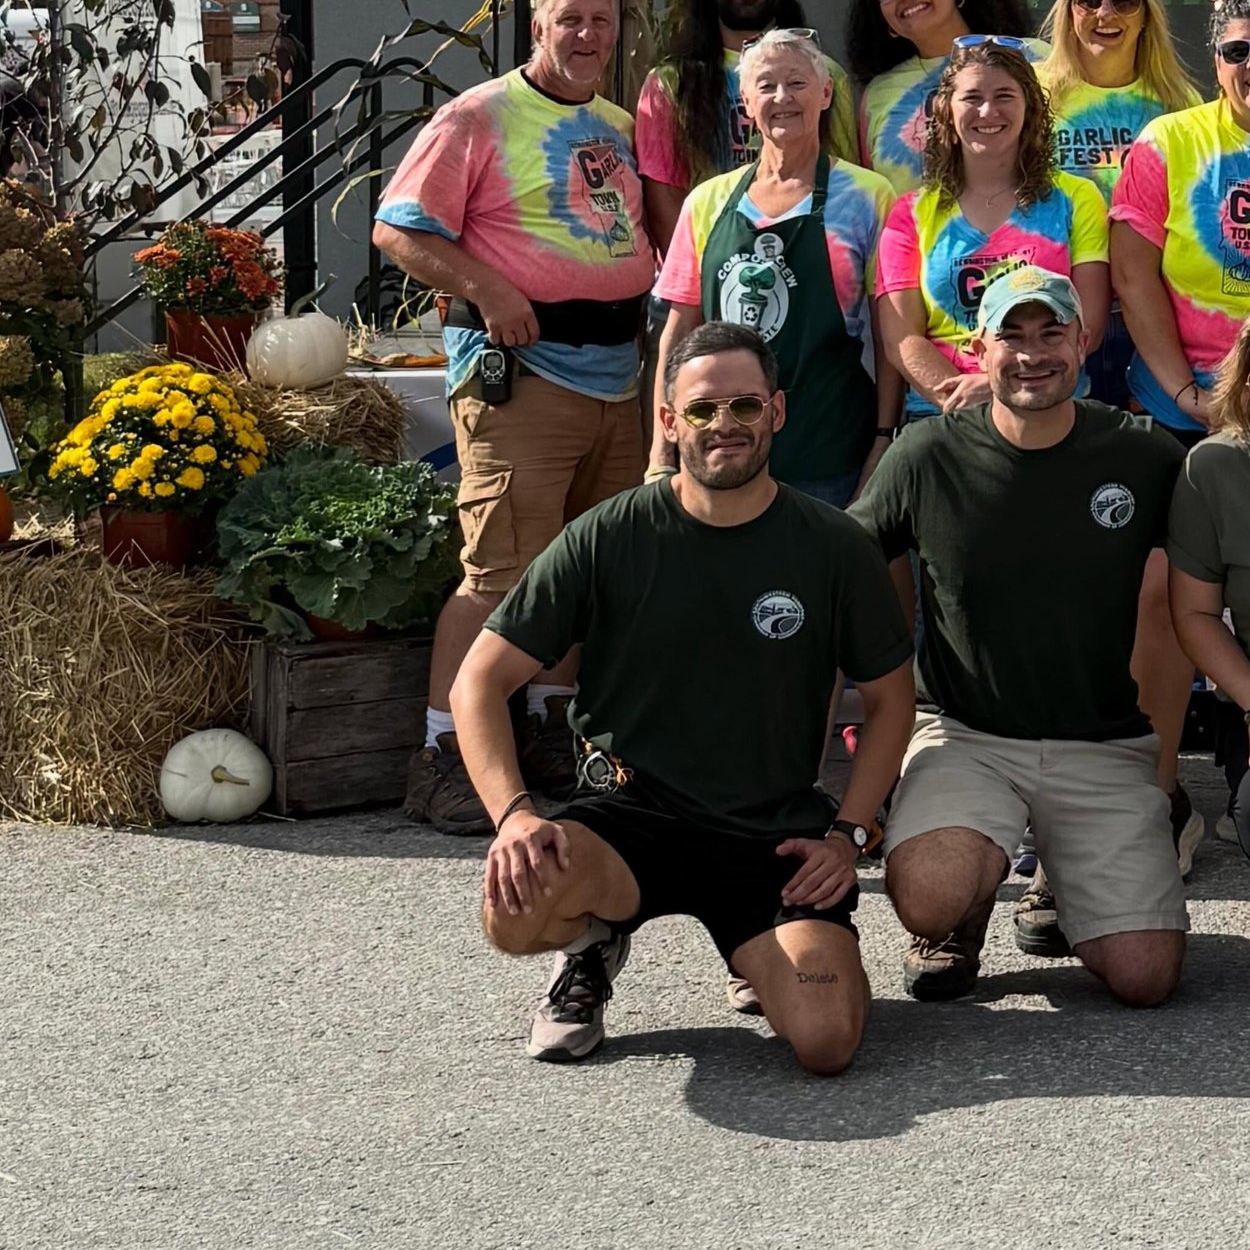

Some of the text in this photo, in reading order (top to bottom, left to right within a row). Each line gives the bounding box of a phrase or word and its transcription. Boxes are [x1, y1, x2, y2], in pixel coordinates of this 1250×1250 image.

[1057, 126, 1133, 147] GARLIC
[1058, 147, 1114, 166] FEST
[589, 190, 621, 207] TOWN
[775, 254, 799, 289] CREW
